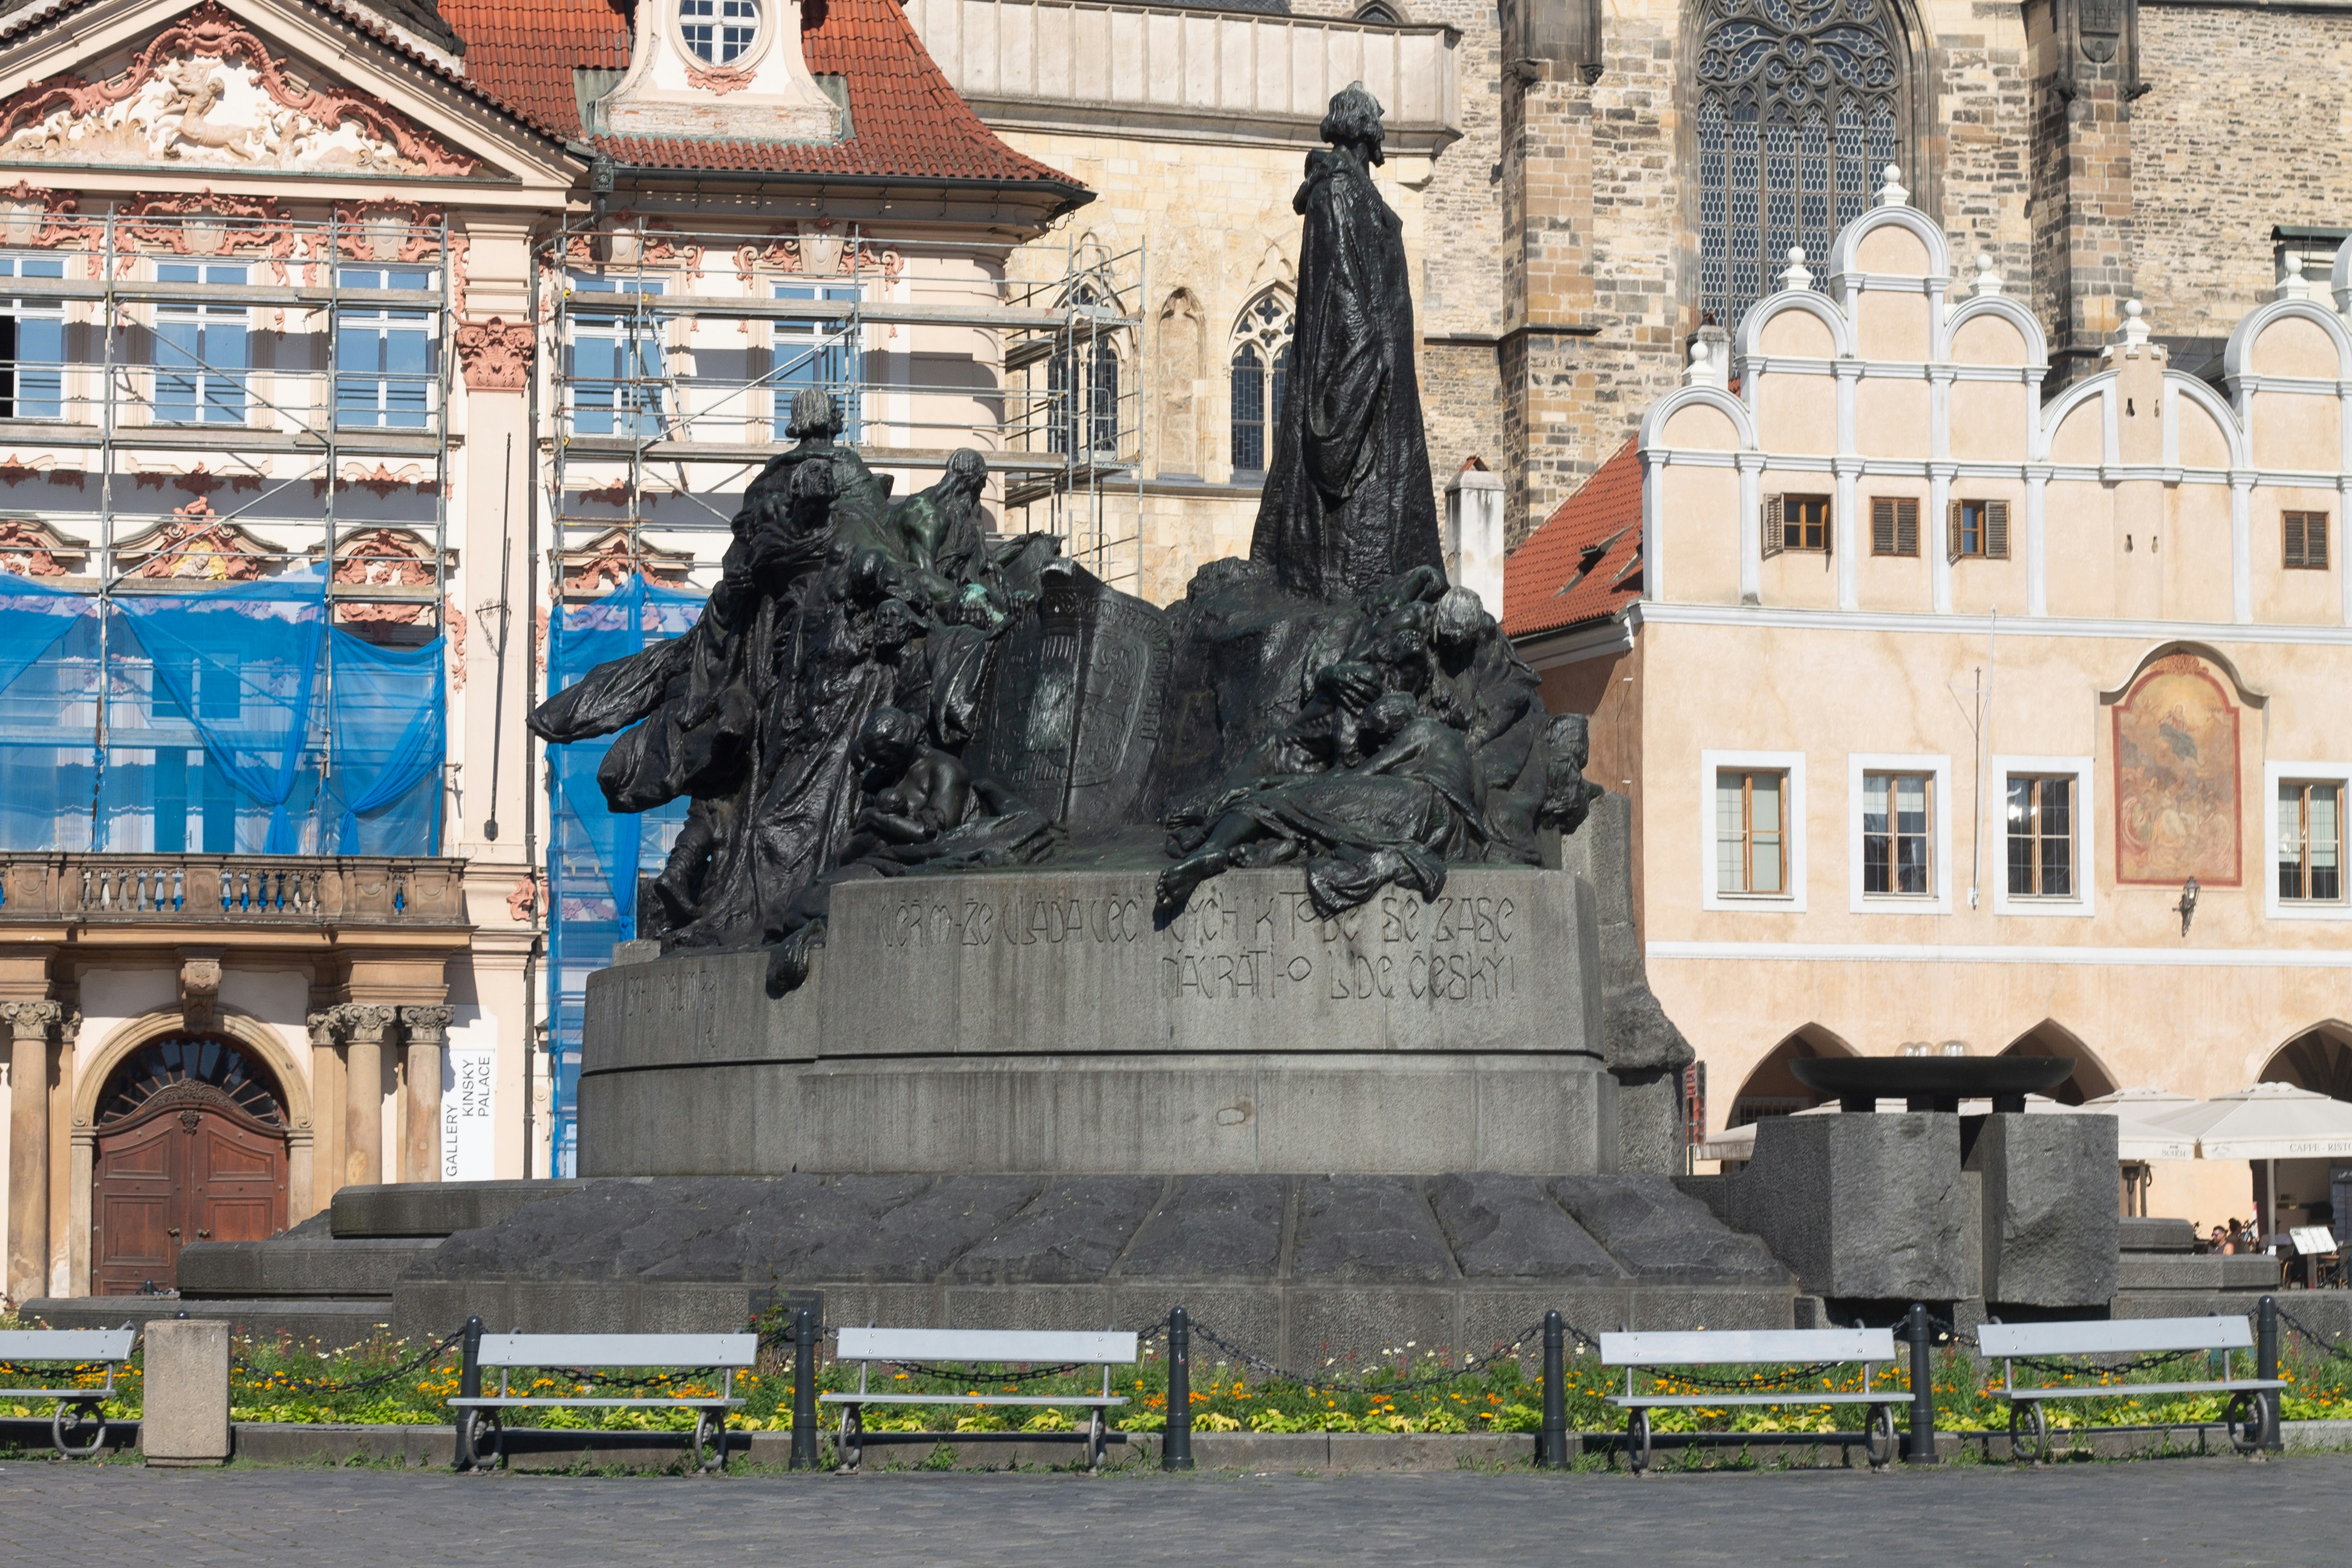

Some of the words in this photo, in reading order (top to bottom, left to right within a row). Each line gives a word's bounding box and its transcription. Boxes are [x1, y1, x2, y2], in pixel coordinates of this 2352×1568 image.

[1435, 897, 1514, 943] ZASE
[463, 1059, 474, 1117] KINSKY
[478, 1056, 490, 1117] PALACE
[446, 1104, 458, 1176] GALLERY
